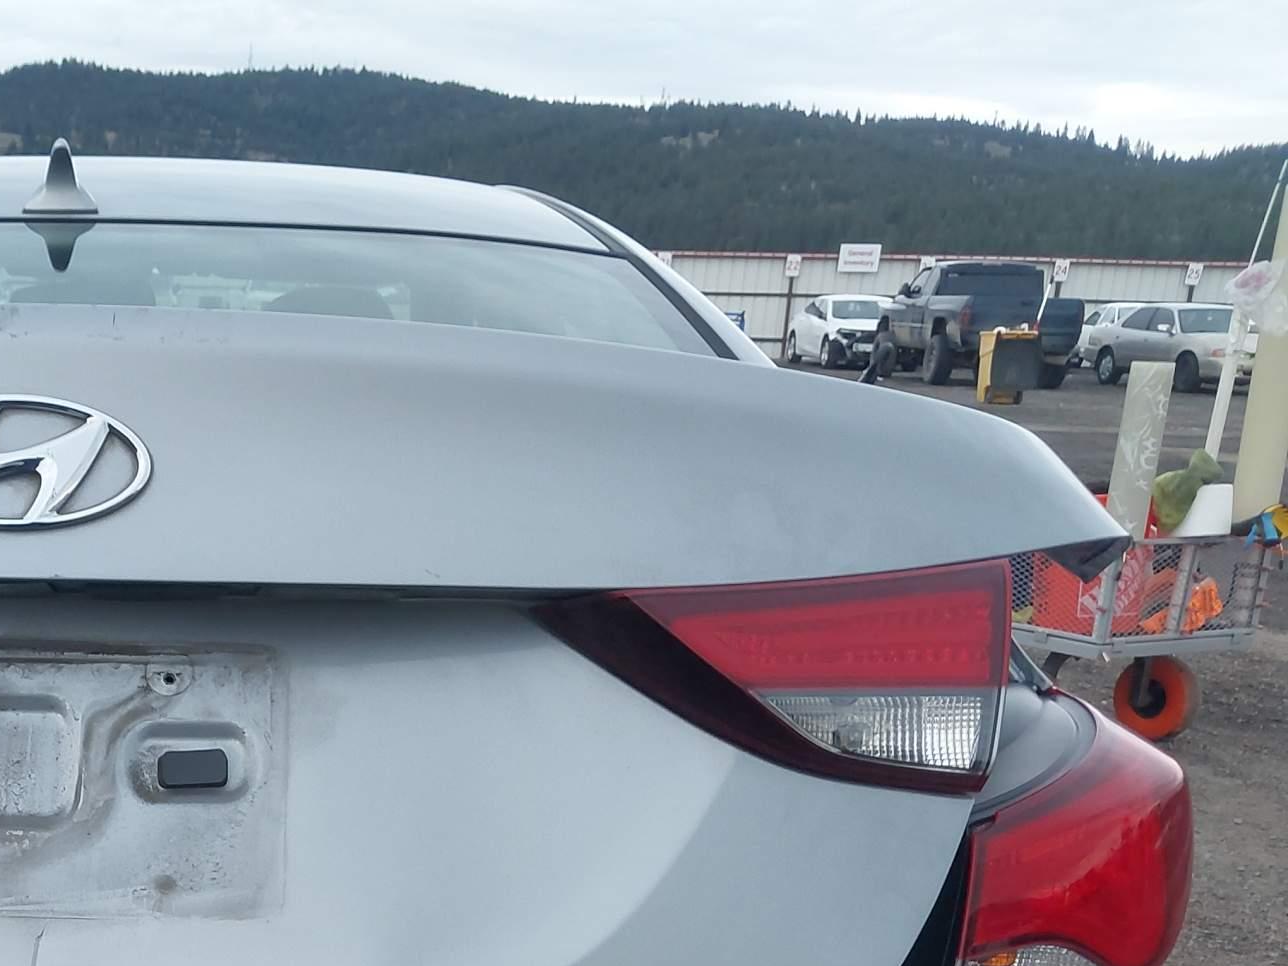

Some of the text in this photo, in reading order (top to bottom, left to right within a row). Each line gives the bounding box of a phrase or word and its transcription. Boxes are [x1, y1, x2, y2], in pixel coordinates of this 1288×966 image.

[787, 260, 800, 272] 22
[1055, 264, 1068, 276] 24
[1187, 267, 1201, 280] 25
